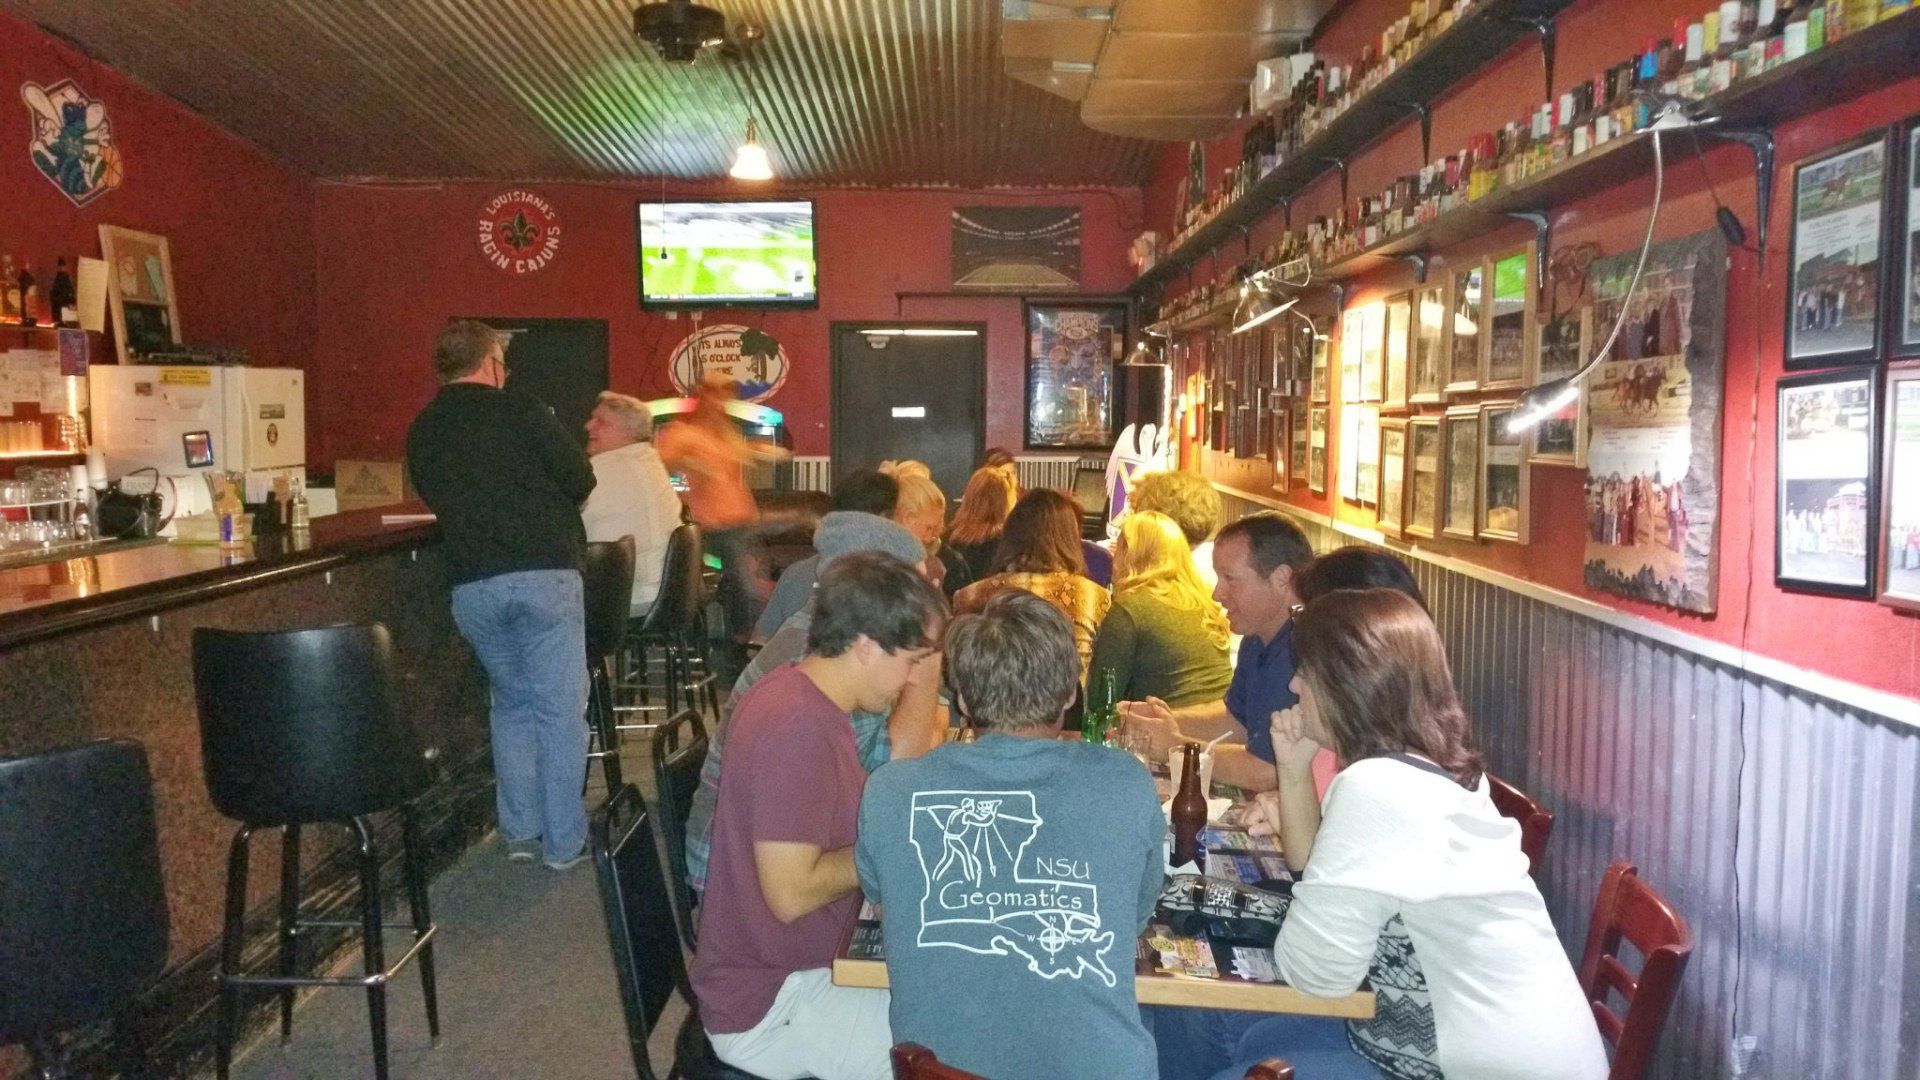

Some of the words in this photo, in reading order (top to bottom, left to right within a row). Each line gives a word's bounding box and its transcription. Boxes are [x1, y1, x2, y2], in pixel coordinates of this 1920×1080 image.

[486, 191, 555, 221] LOUISIANA'S
[480, 220, 510, 269] RAGIN
[515, 226, 560, 273] CAJUNS
[714, 339, 742, 349] ALWAYS
[709, 353, 742, 363] O'CLOCK
[1036, 857, 1090, 880] NSU
[939, 880, 1083, 910] Geomatics
[1049, 957, 1055, 965] S
